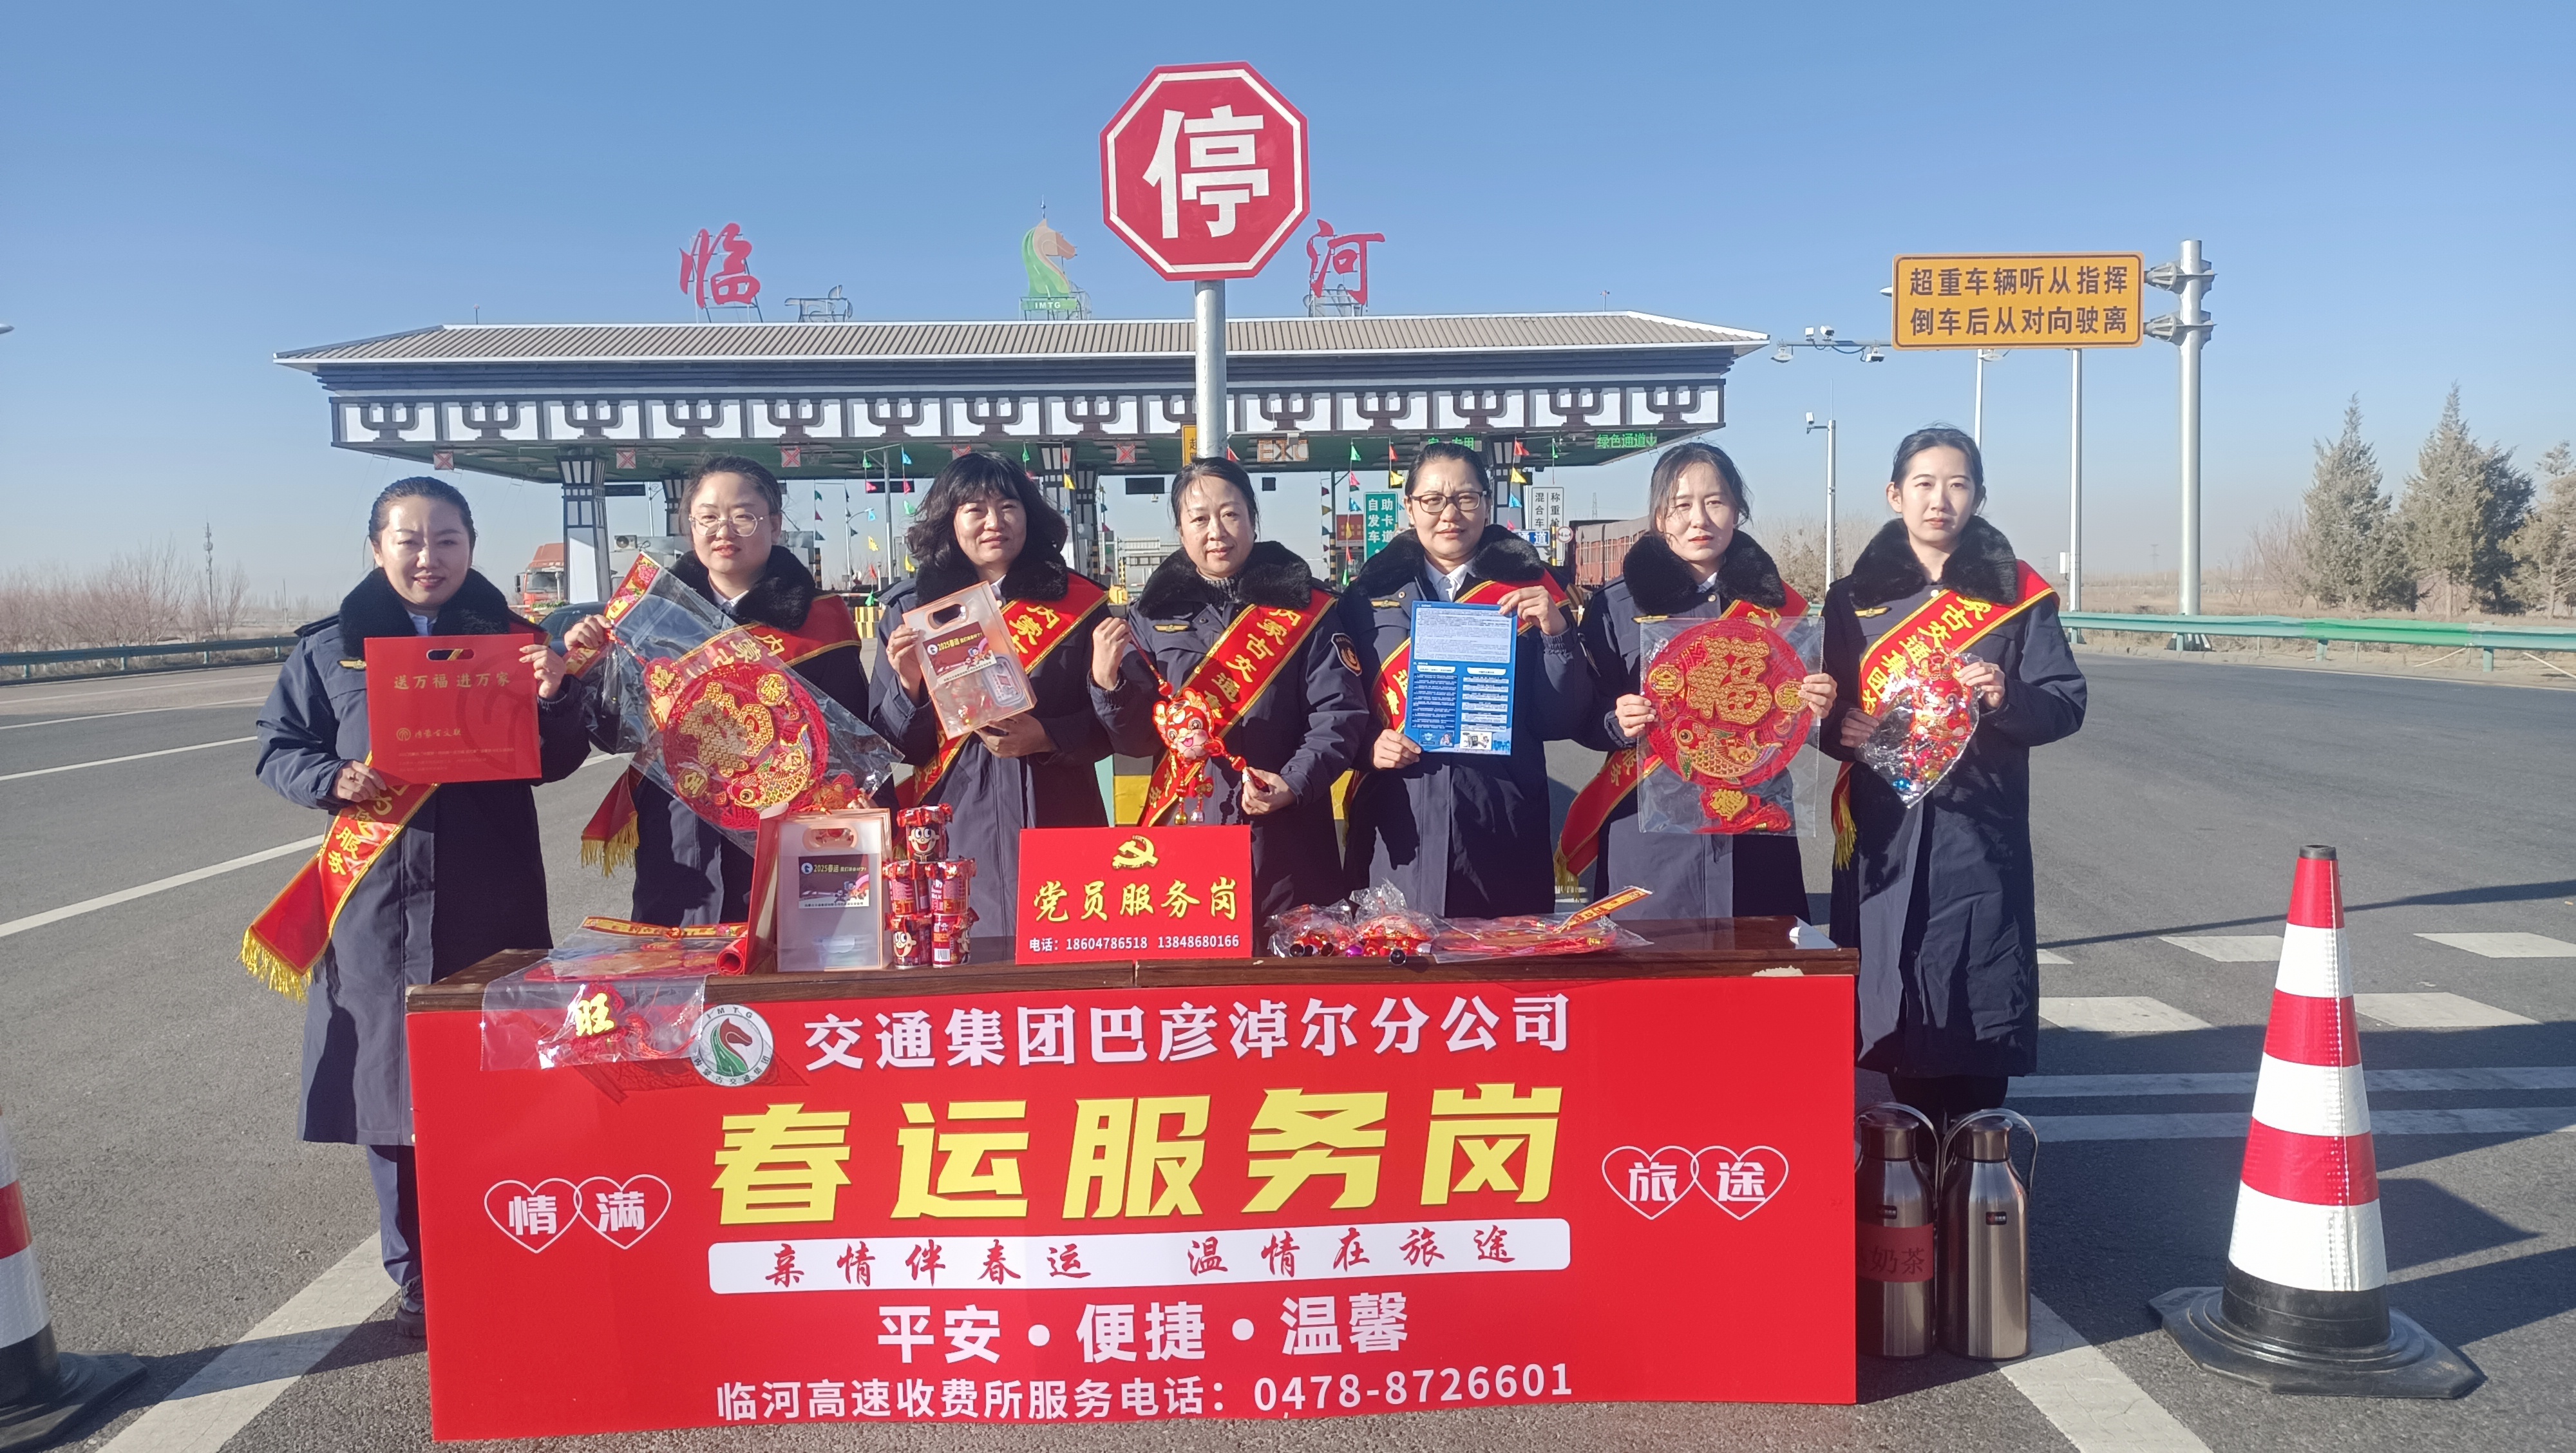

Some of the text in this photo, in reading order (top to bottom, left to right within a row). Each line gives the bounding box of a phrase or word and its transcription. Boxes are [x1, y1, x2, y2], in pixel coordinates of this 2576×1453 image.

[1142, 104, 1269, 239] 停
[679, 219, 1385, 309] 临 河
[1909, 266, 2128, 296] 超重车辆听从指挥
[1910, 306, 2128, 336] 倒车后从对向驶离
[1597, 433, 1646, 448] 绿色通道
[1368, 499, 1394, 511] 自助
[1368, 514, 1394, 527] 发卡
[1368, 530, 1394, 543] 车道
[394, 671, 511, 690] 送万福 进万家
[1687, 636, 1772, 725] 福
[813, 864, 839, 873] 2025春运
[1034, 876, 1237, 922] 党员服务岗
[1157, 935, 1240, 949] 13848680166
[575, 992, 614, 1036] 旺
[706, 1007, 752, 1019] IMTG
[805, 994, 1569, 1071] 交通集团巴彦淖尔分公司
[694, 1056, 770, 1085] 内蒙古交通集团
[712, 1084, 1563, 1224] 春运服务岗
[1628, 1162, 1766, 1202] 旅途
[508, 1195, 645, 1233] 情满
[765, 1226, 1516, 1287] 亲情伴春运 温情在旅途
